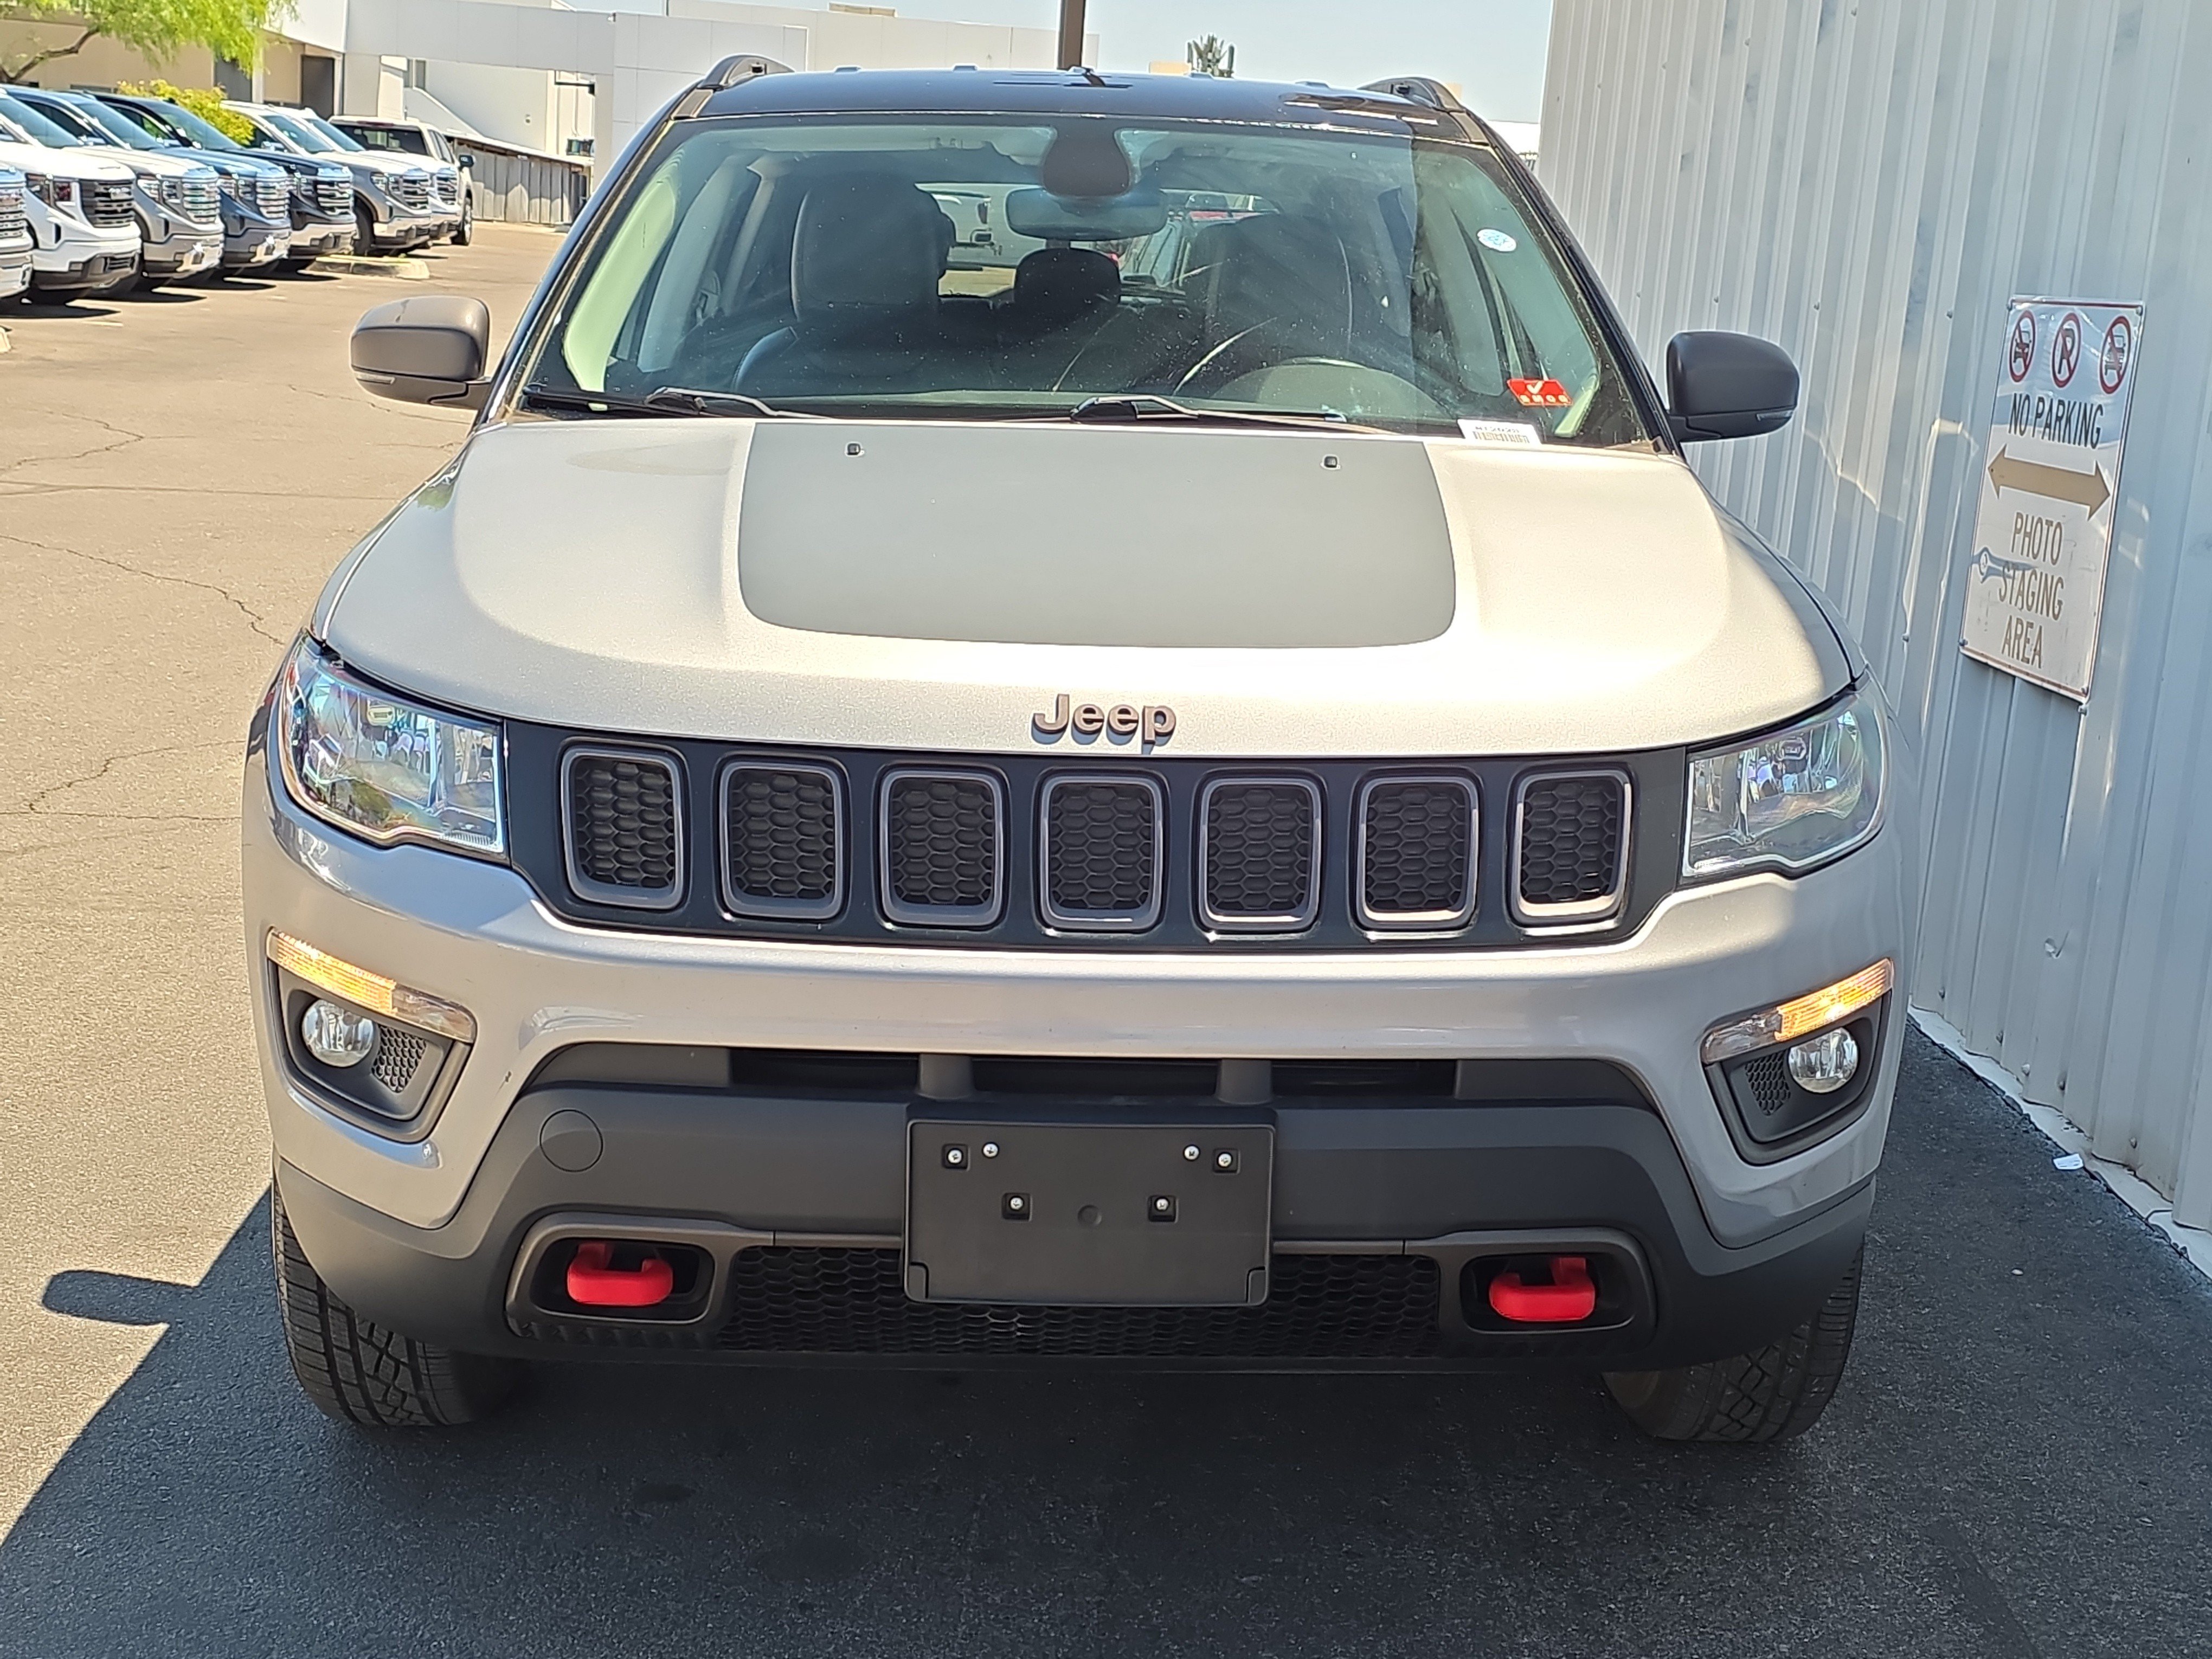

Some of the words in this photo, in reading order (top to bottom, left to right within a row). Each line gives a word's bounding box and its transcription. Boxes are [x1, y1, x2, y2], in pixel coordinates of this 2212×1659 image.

[2008, 393, 2030, 436] NO
[2031, 396, 2104, 449] PARKING
[2011, 512, 2063, 565] PHOTO
[1999, 563, 2064, 620] STAGING
[2002, 615, 2042, 668] AREA
[1032, 693, 1176, 744] Jeep
